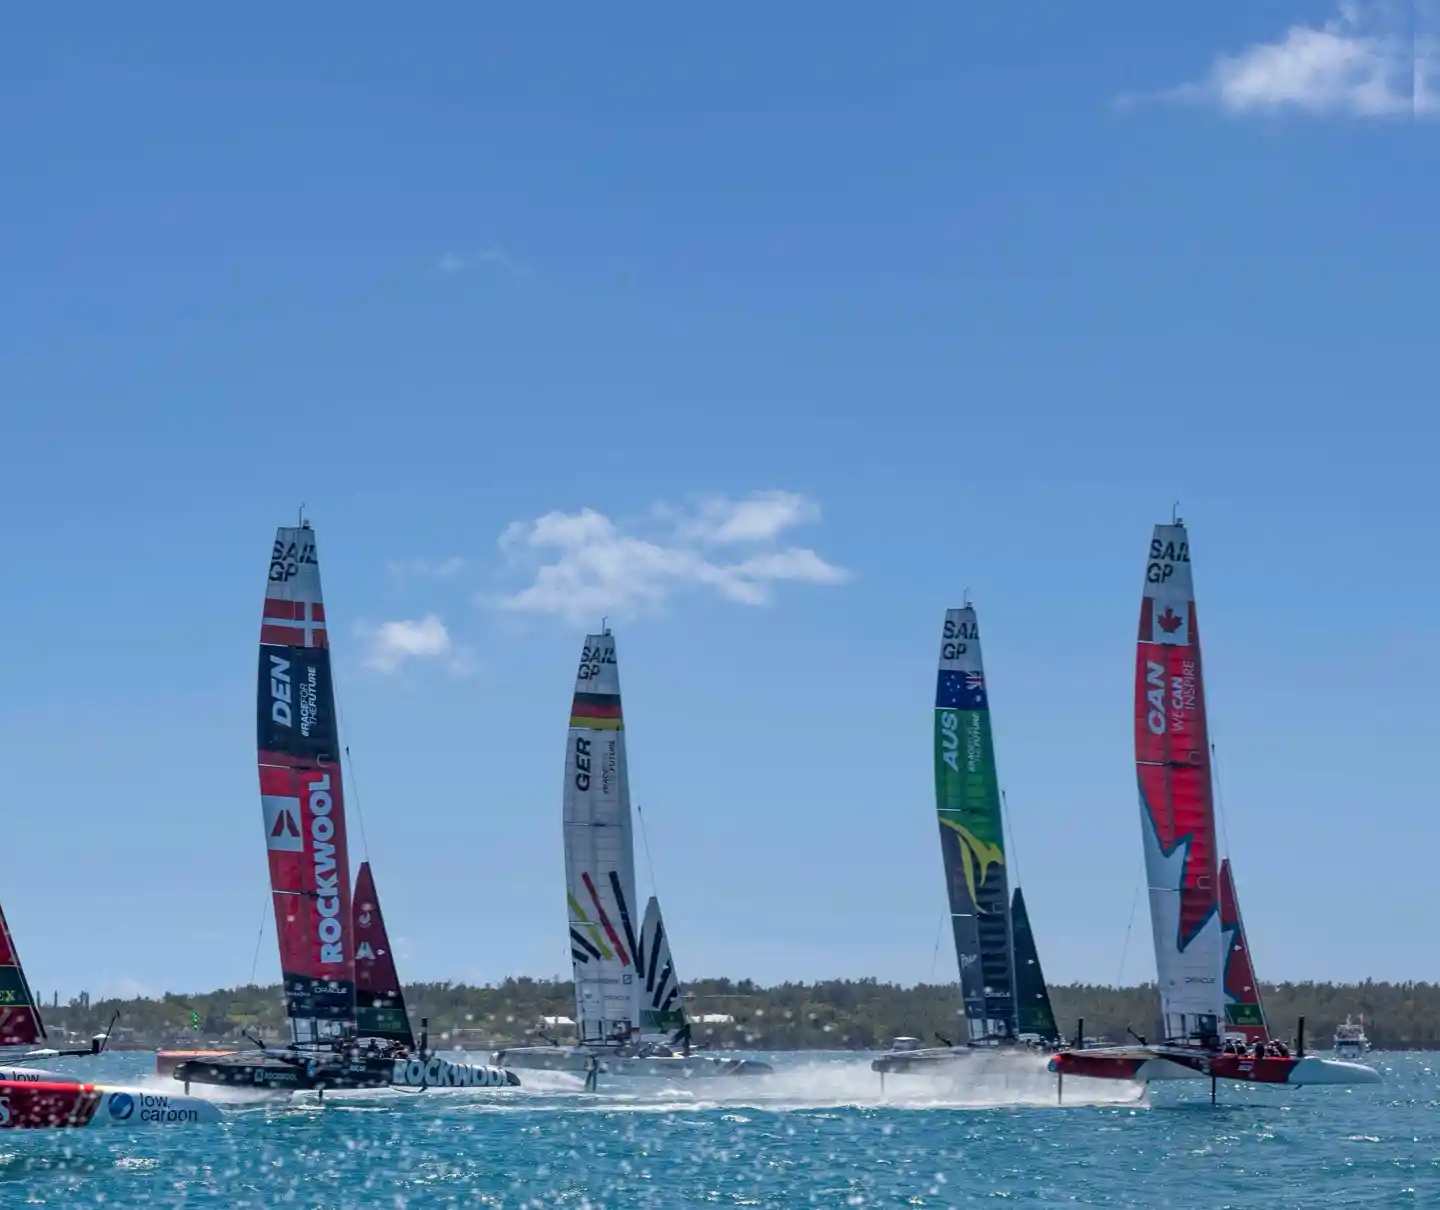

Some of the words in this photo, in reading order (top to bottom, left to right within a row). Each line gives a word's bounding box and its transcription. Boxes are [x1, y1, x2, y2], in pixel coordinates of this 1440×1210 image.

[272, 541, 318, 564] SAIL
[1149, 539, 1191, 562] SAIL
[269, 563, 298, 582] GP
[1147, 563, 1174, 584] GP
[580, 646, 617, 664] SAIL
[943, 643, 967, 660] GP
[578, 664, 600, 680] GP
[270, 655, 292, 727] DEN
[1182, 660, 1195, 710] INSPIRE
[1147, 659, 1166, 735] CAN
[942, 711, 959, 773] AUS
[576, 737, 591, 791] GER
[308, 773, 343, 963] ROCKWOOL
[12, 1071, 40, 1082] low
[392, 1058, 511, 1088] ROCKWOOL
[140, 1092, 168, 1108] low
[140, 1104, 199, 1123] carbon
